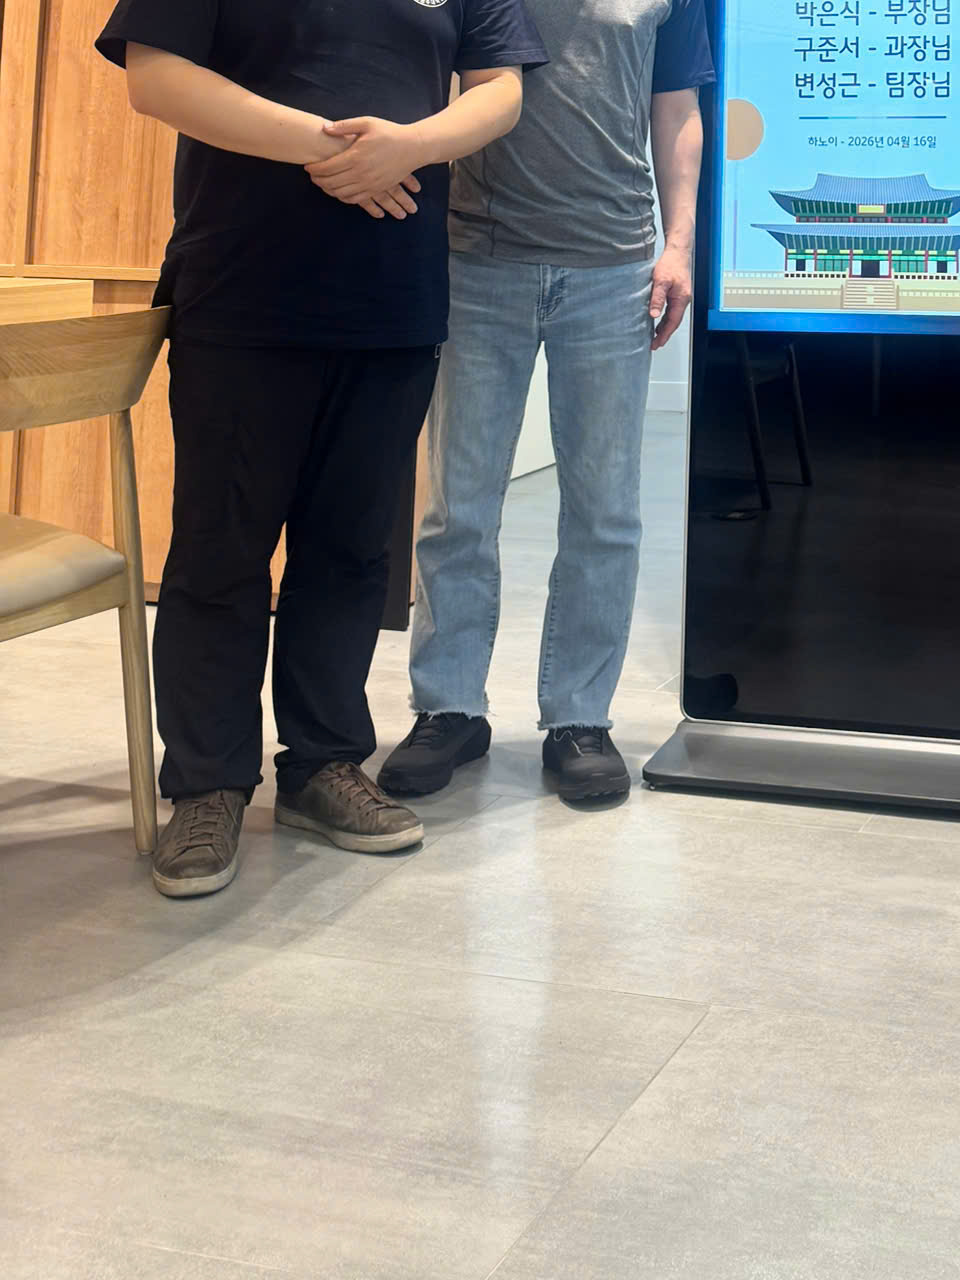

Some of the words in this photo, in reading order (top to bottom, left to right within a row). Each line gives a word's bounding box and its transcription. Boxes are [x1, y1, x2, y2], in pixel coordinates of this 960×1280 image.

[795, 0, 860, 26] 박은식
[884, 0, 951, 25] 부장님
[794, 36, 860, 62] 구준서
[884, 35, 951, 62] 과장님
[795, 72, 861, 99] 변성근
[885, 71, 951, 99] 팀장님
[808, 135, 838, 148] 하노이
[847, 135, 884, 148] 2026년
[887, 135, 910, 148] 04월
[913, 135, 937, 148] 16일
